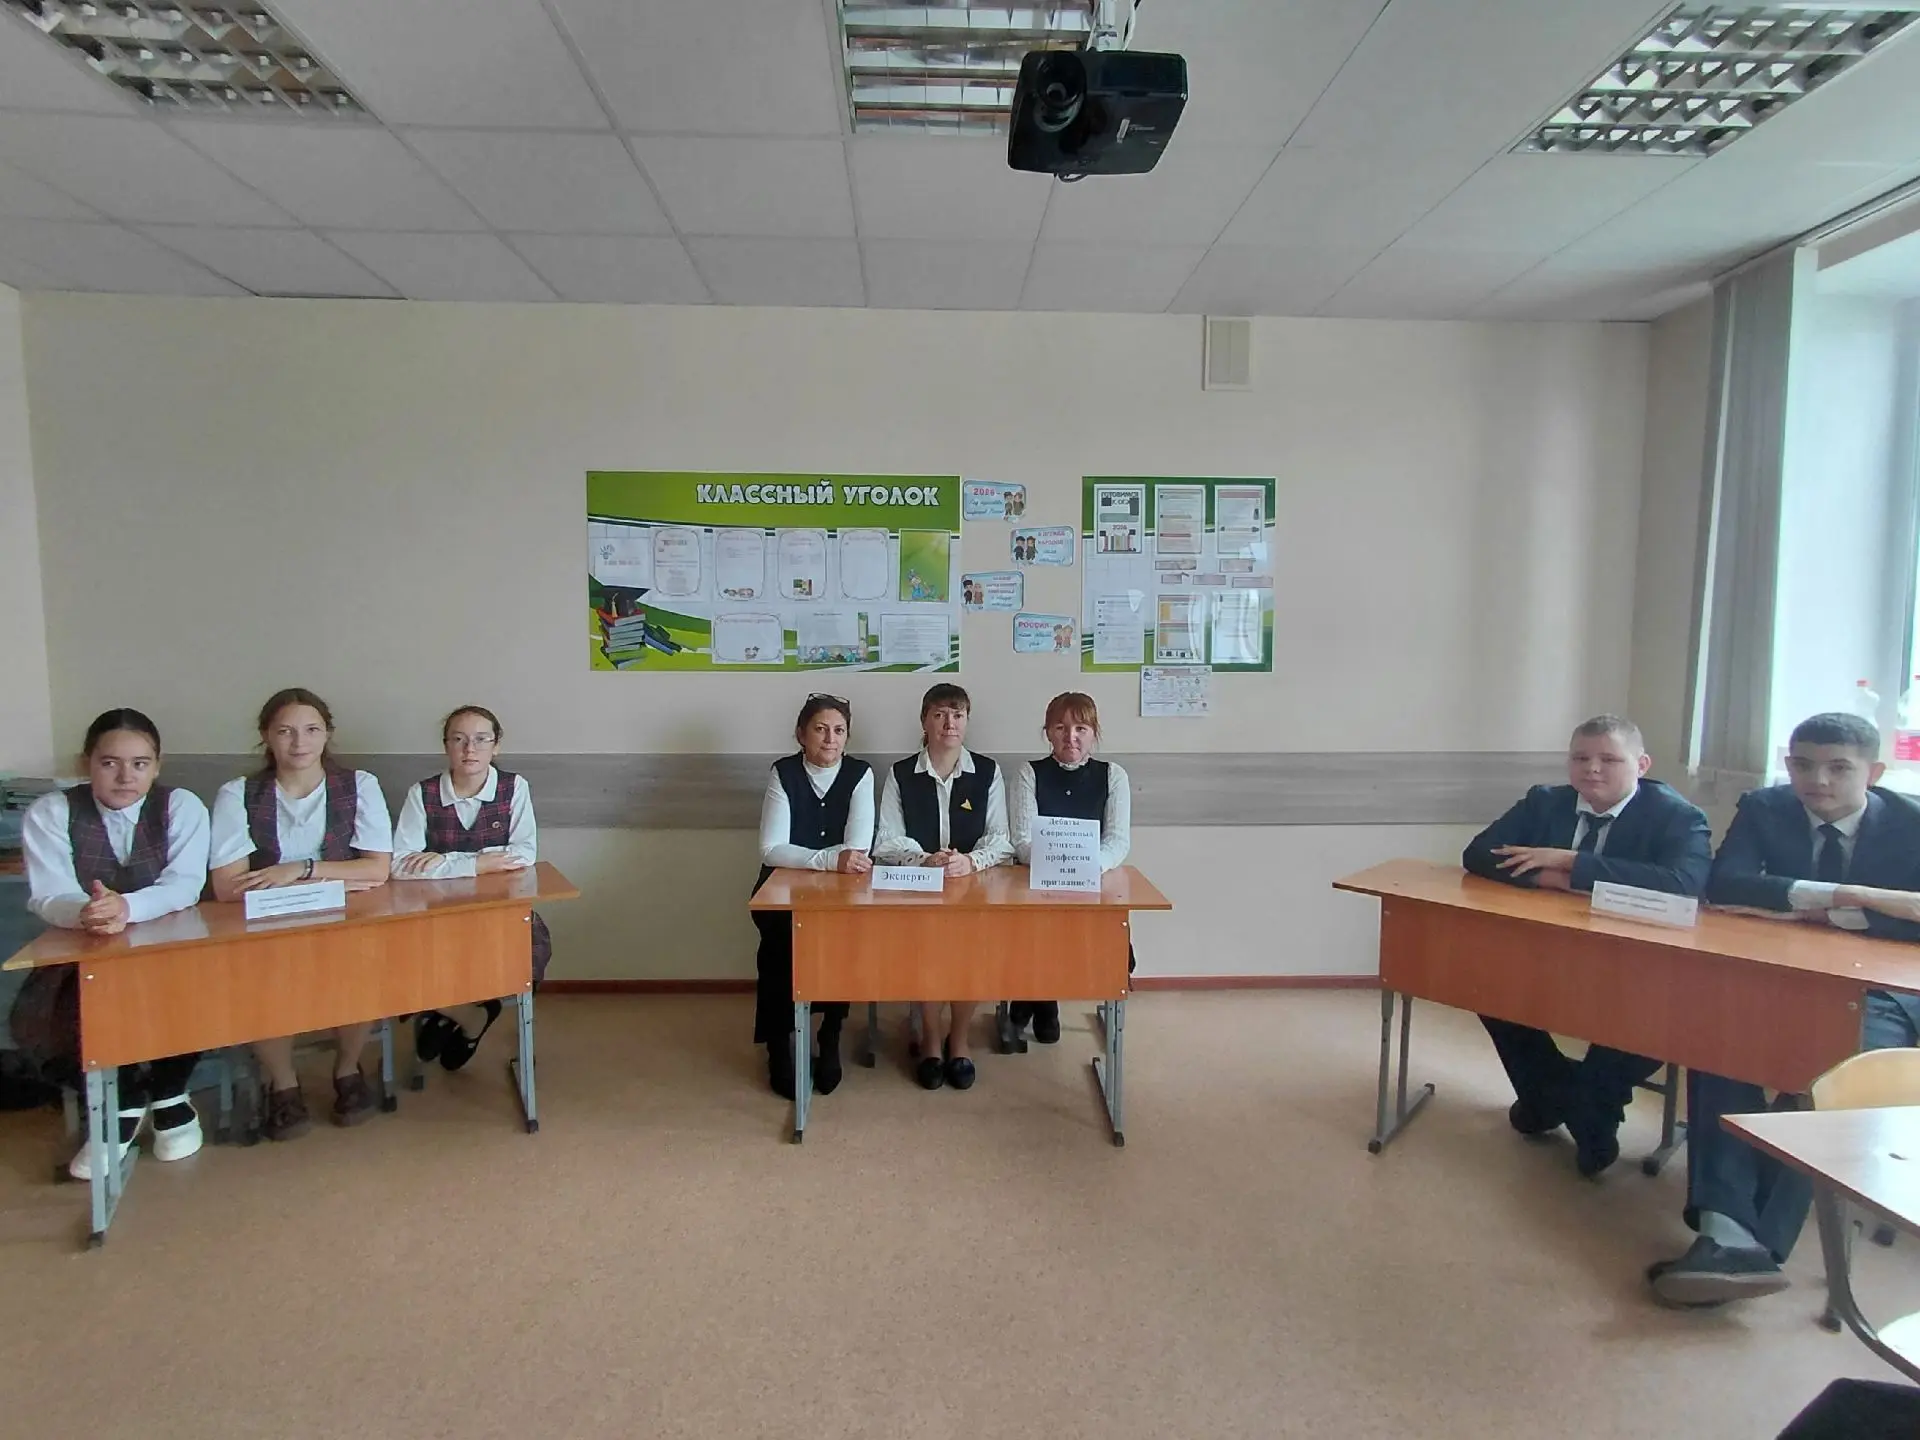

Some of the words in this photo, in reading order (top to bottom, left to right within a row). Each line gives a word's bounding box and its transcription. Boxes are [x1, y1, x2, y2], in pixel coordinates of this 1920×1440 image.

[696, 479, 835, 504] КЛАССНЫЙ
[842, 485, 940, 506] УГОЛОК
[881, 871, 931, 883] Эксперты
